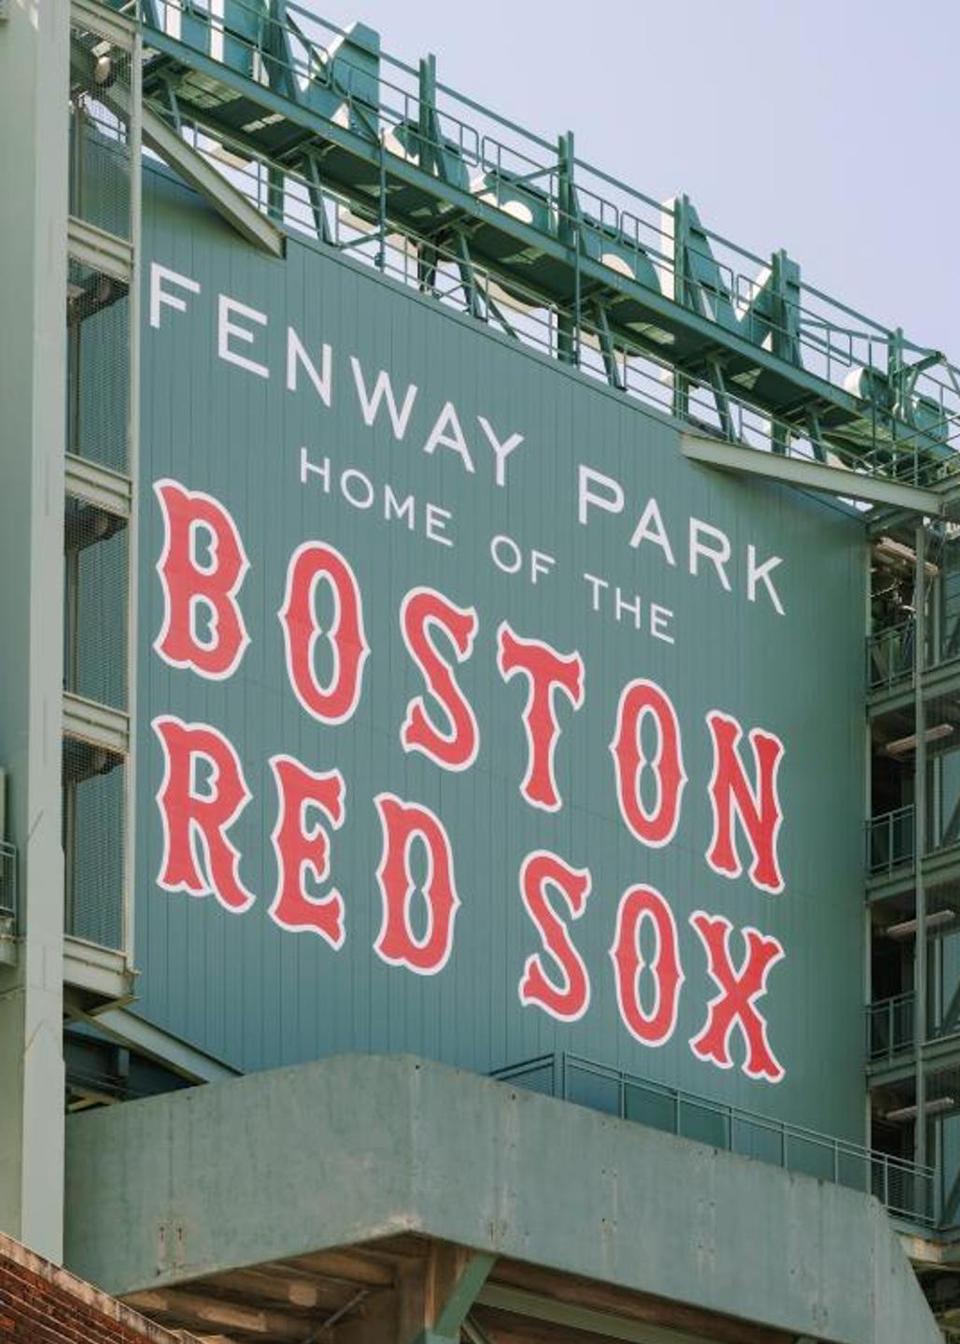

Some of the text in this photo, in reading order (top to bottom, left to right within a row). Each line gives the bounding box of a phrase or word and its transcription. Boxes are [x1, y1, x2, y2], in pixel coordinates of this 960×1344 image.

[150, 263, 785, 615] FENWAY PARK
[300, 448, 675, 644] HOME OF THE
[152, 478, 786, 895] BOSTON
[151, 715, 786, 1084] RED SOX
